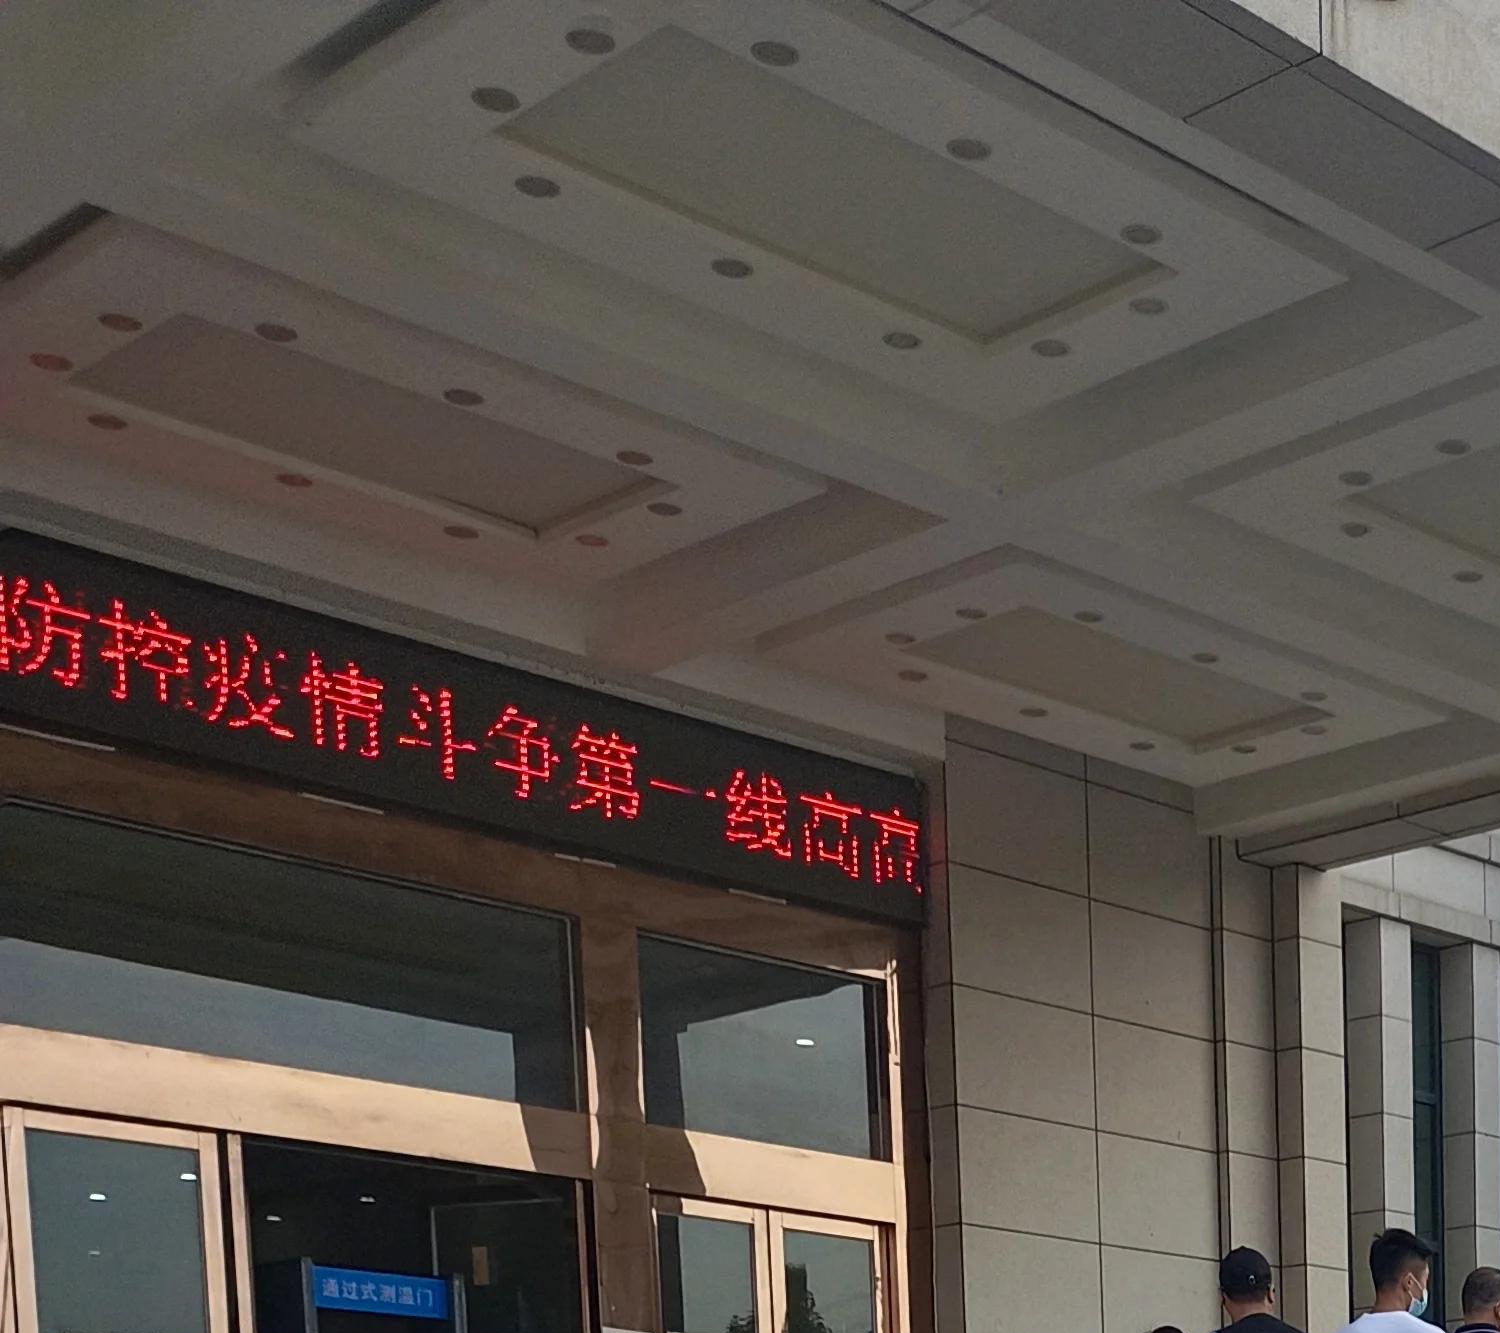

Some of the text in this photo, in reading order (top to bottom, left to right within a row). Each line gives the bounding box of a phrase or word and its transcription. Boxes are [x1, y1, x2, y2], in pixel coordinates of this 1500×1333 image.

[321, 1278, 433, 1307] 通过式测温门
